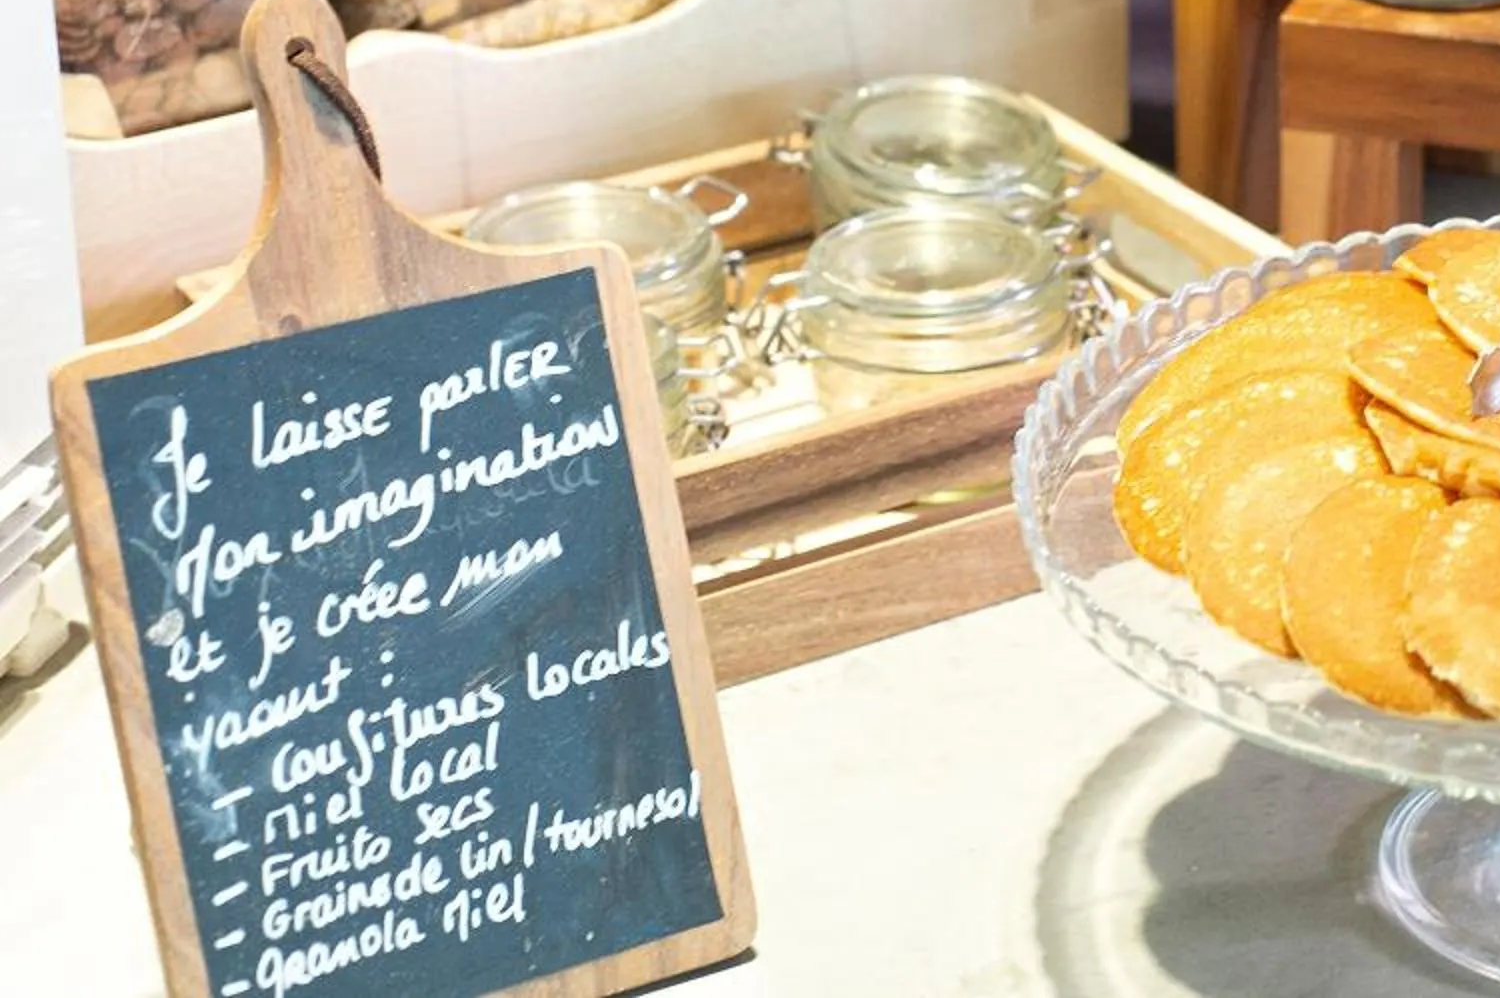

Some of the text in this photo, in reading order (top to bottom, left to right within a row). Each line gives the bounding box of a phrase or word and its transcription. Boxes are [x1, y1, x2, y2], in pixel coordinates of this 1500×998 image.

[152, 405, 212, 541] Je
[249, 601, 296, 690] je
[439, 529, 563, 607] mon
[261, 825, 392, 896] Fruits
[394, 852, 451, 901] de
